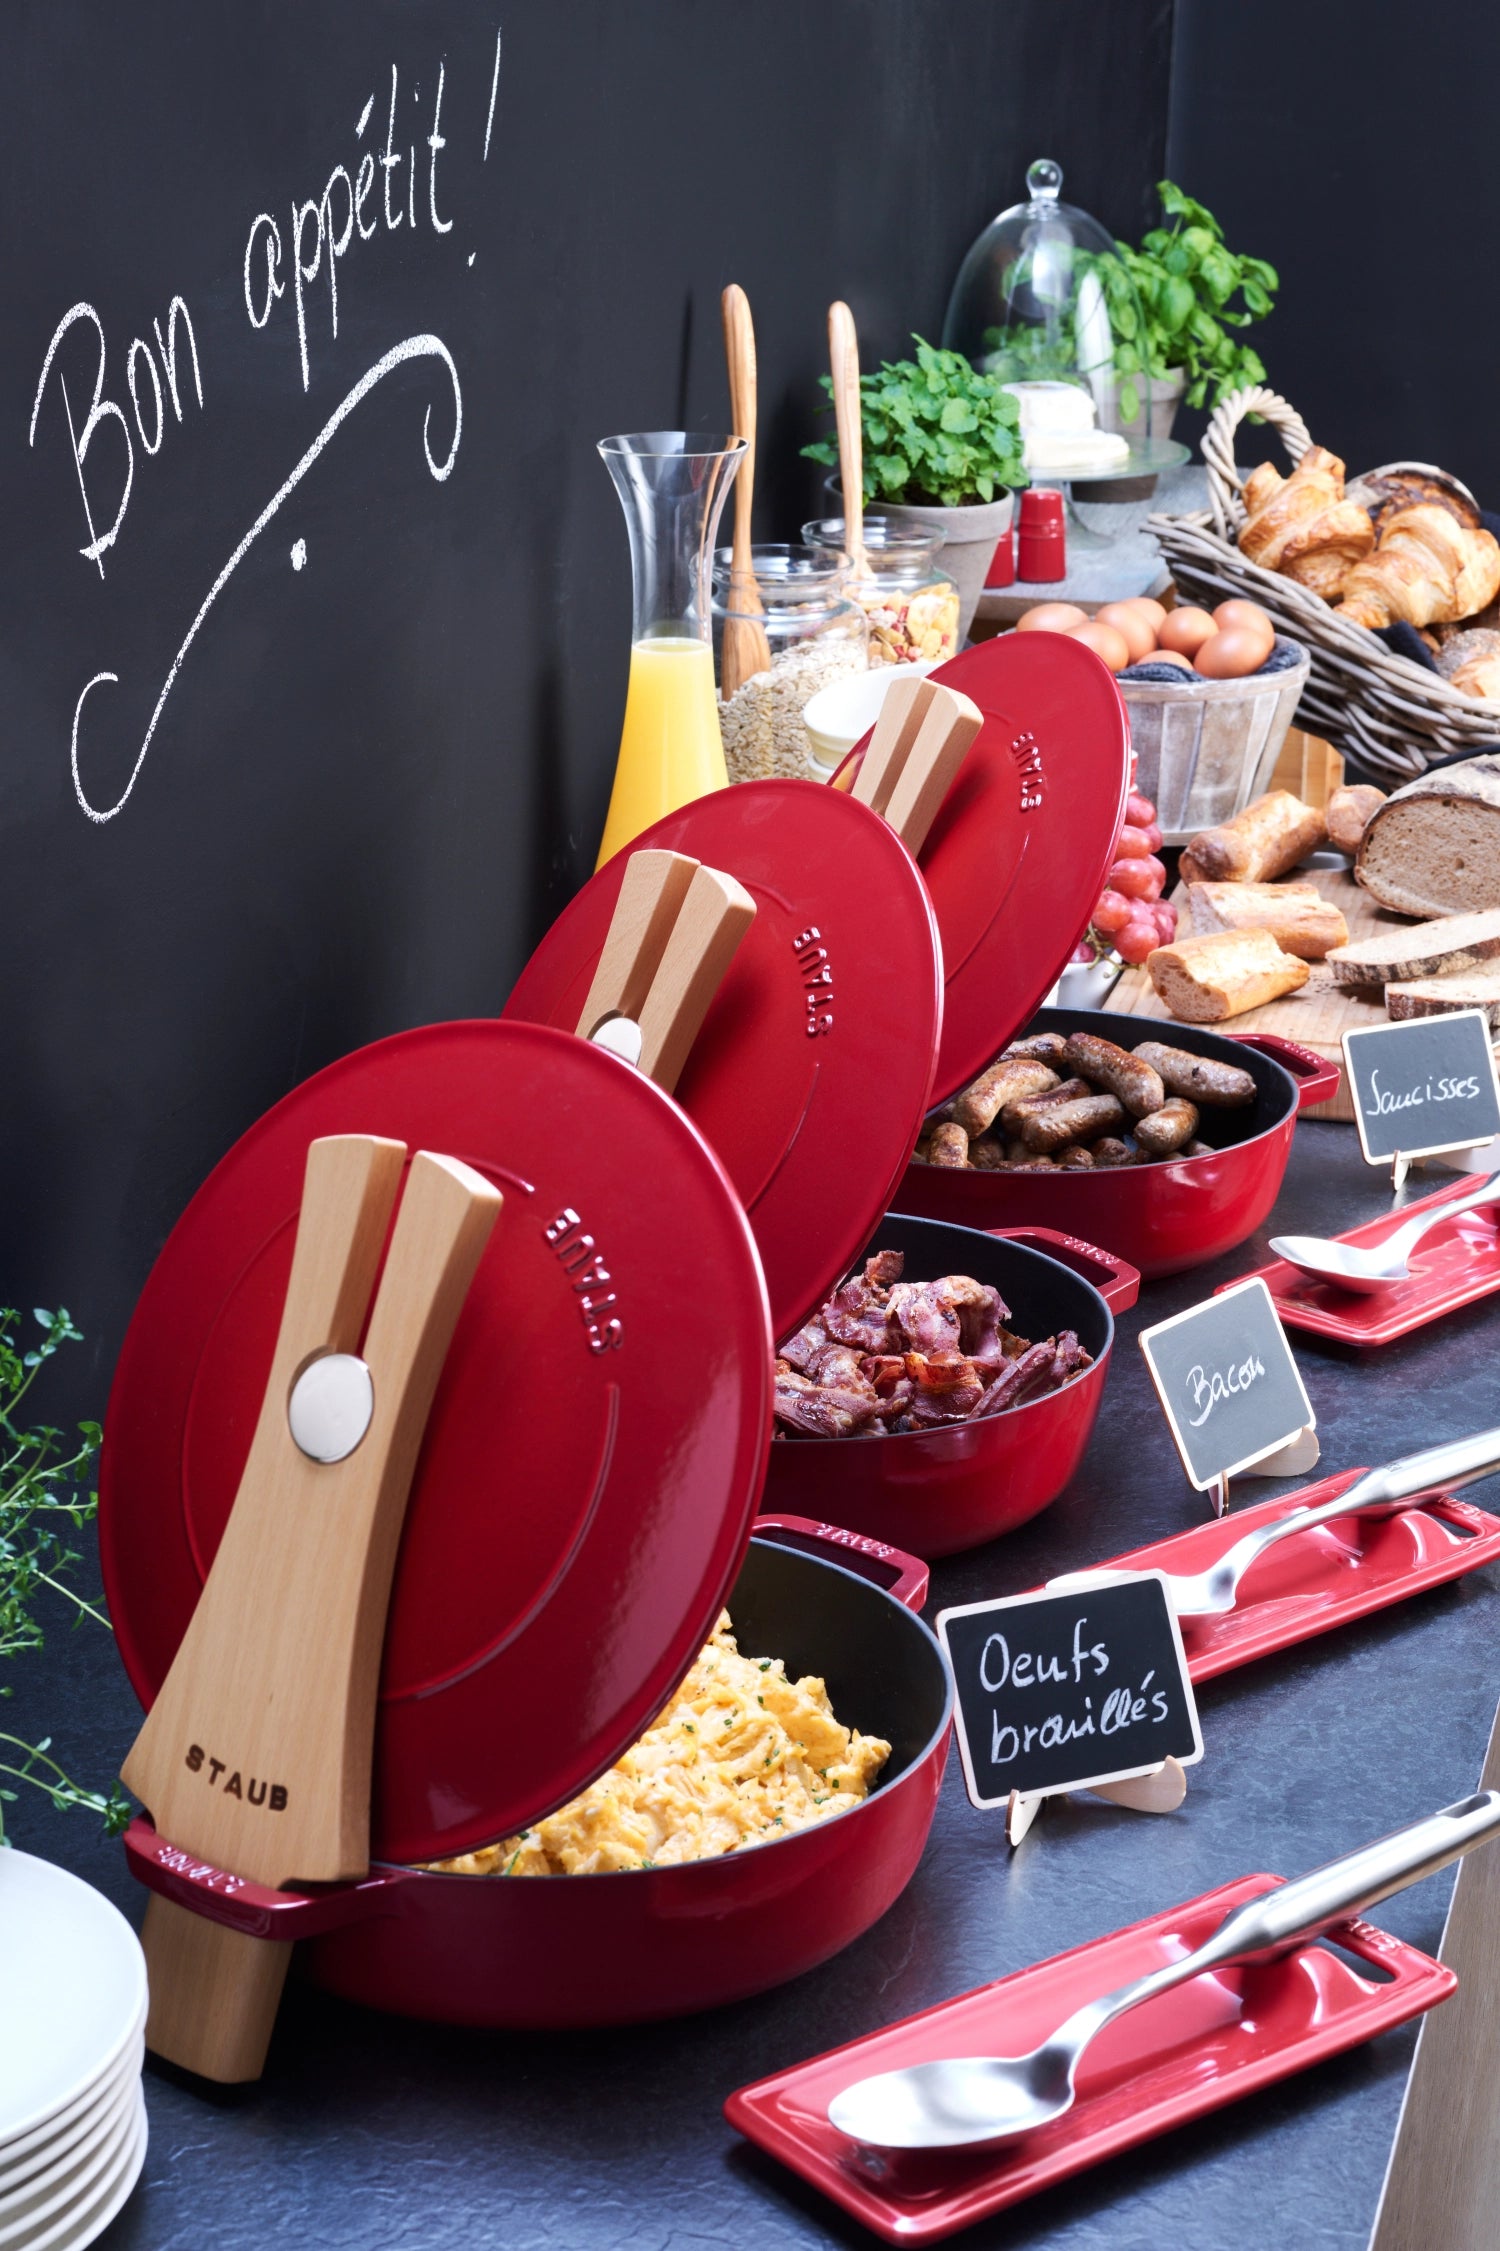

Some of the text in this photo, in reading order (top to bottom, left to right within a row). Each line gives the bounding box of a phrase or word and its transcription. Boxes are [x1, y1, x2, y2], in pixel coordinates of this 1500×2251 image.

[30, 296, 204, 580] Bon
[1010, 731, 1043, 813] STAUB
[792, 927, 834, 1038] STAUB
[1365, 1069, 1481, 1116] Saucisses
[544, 1207, 623, 1354] STAUB
[1184, 1353, 1266, 1428] Bacon
[979, 1617, 1110, 1693] Oeufs
[185, 1743, 289, 1812] STAUB
